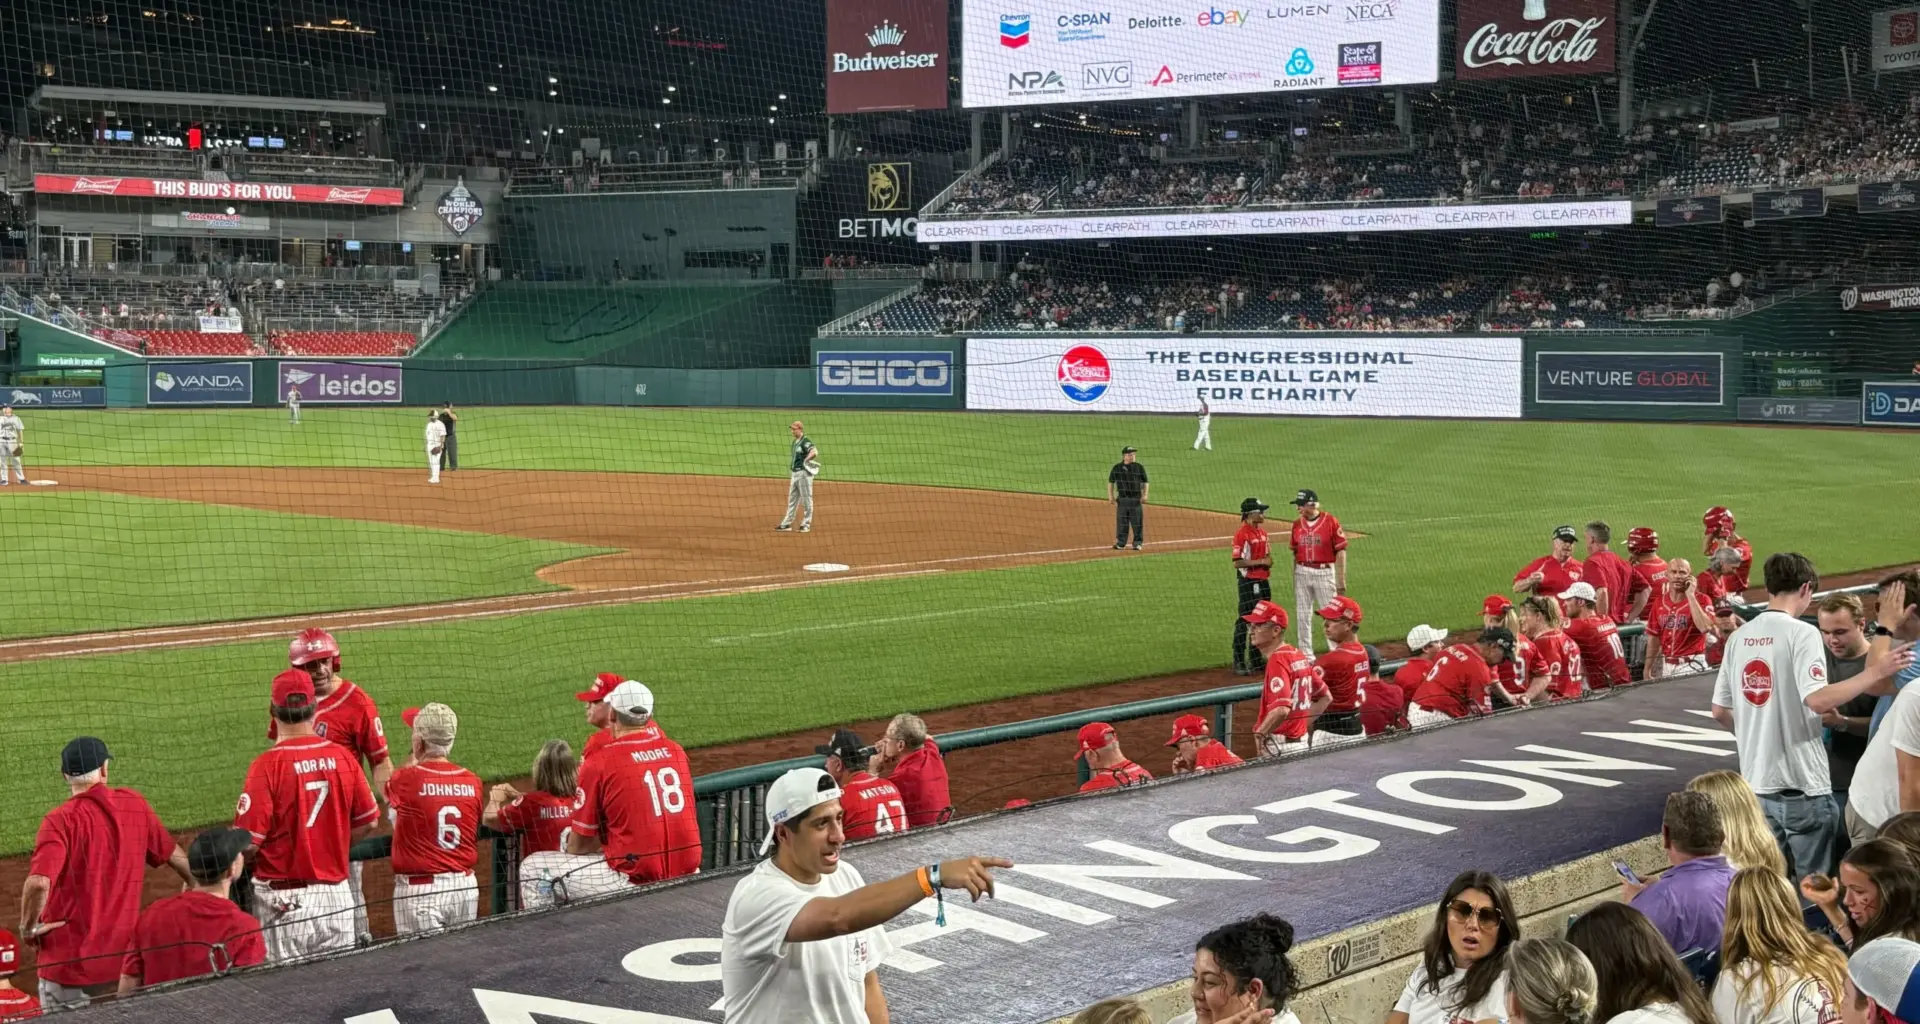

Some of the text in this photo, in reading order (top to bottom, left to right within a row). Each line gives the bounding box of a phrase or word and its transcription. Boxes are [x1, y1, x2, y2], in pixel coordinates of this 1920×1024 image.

[1197, 6, 1250, 28] ebay
[1266, 4, 1331, 19] LUMEN
[1346, 3, 1394, 20] NECA
[1463, 16, 1607, 69] Coca-Cola
[832, 50, 939, 73] Budweiser
[1008, 70, 1065, 90] NPA
[1086, 65, 1130, 85] NVG
[1176, 71, 1228, 83] Perimeter
[1273, 77, 1326, 89] RADIANT
[152, 180, 186, 196] THIS
[188, 182, 231, 198] BUD'S
[234, 183, 262, 199] FOR
[264, 184, 296, 200] YOU.
[437, 206, 483, 217] CHAMPIONS
[445, 199, 476, 208] WORLD
[924, 207, 1616, 238] CLEARPATH CLEARPATH CLEARPATH CLEARPATH CLEARPATH CLEARPATH CLEARPATH CLEARPATH
[1889, 296, 1920, 309] NATIO
[1145, 351, 1414, 365] THE CONGRESSIONAL
[176, 375, 244, 387] VANDA
[821, 359, 949, 387] GEICO
[1175, 369, 1379, 383] BASEBALL GAME
[1547, 370, 1713, 387] VENTURE GLOBAL
[319, 371, 397, 397] leidos
[51, 389, 82, 400] MGM
[1196, 387, 1358, 401] FOR CHARITY
[1775, 404, 1796, 415] RTX
[1743, 636, 1774, 647] TOYOTA
[630, 746, 673, 764] MOORE
[293, 757, 337, 775] MORAN
[418, 782, 476, 797] JOHNSON
[643, 766, 686, 818] 18
[858, 785, 897, 800] WATSON
[304, 780, 329, 829] 7
[874, 799, 910, 835] 47
[437, 804, 463, 850] 6
